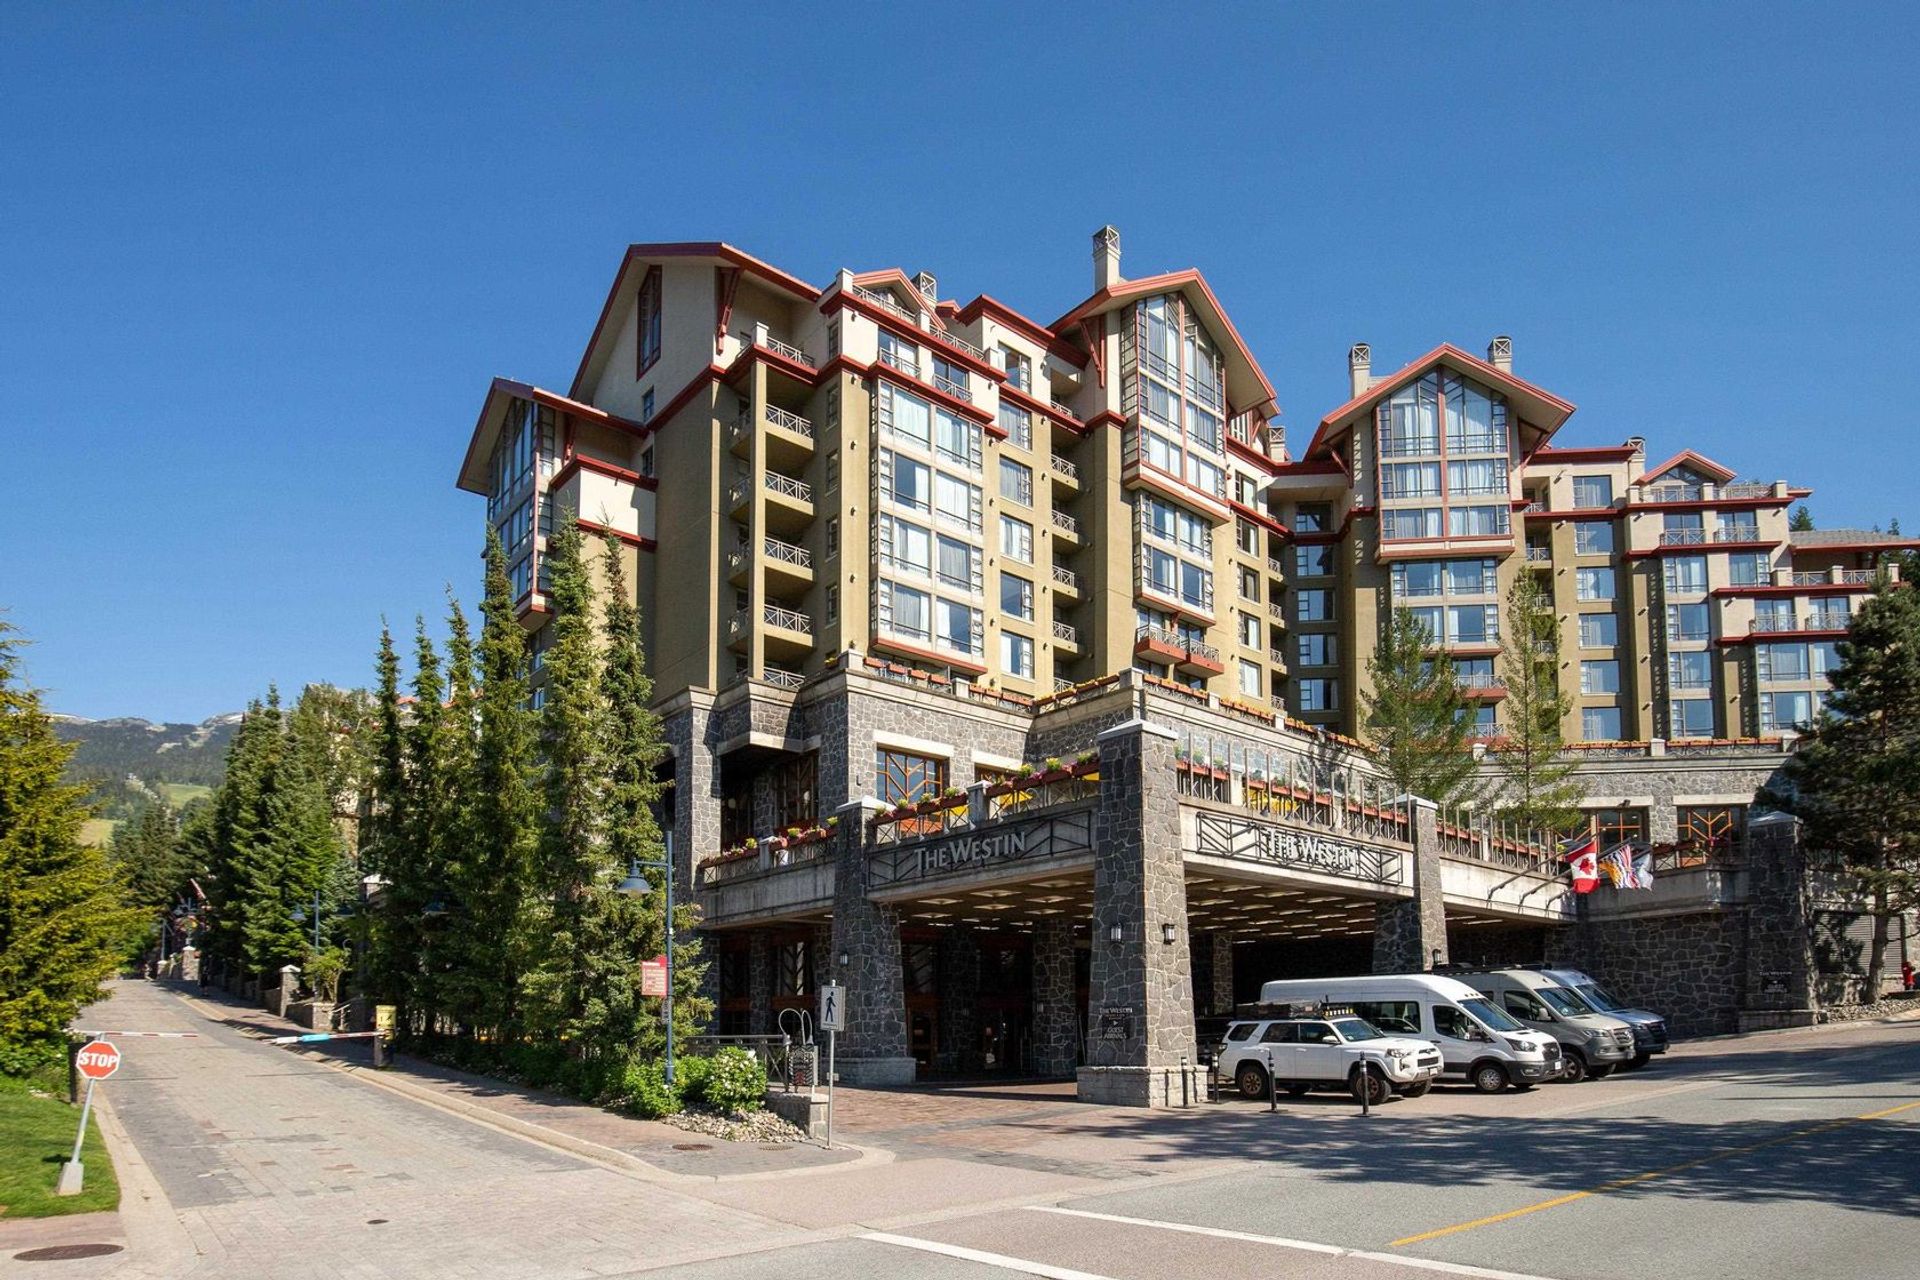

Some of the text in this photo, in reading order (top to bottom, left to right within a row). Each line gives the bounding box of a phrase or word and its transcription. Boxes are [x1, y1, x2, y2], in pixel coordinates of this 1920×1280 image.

[914, 832, 1025, 872] THE WESTIN
[1267, 828, 1358, 870] THE WESTIN
[80, 1052, 117, 1067] STOP
